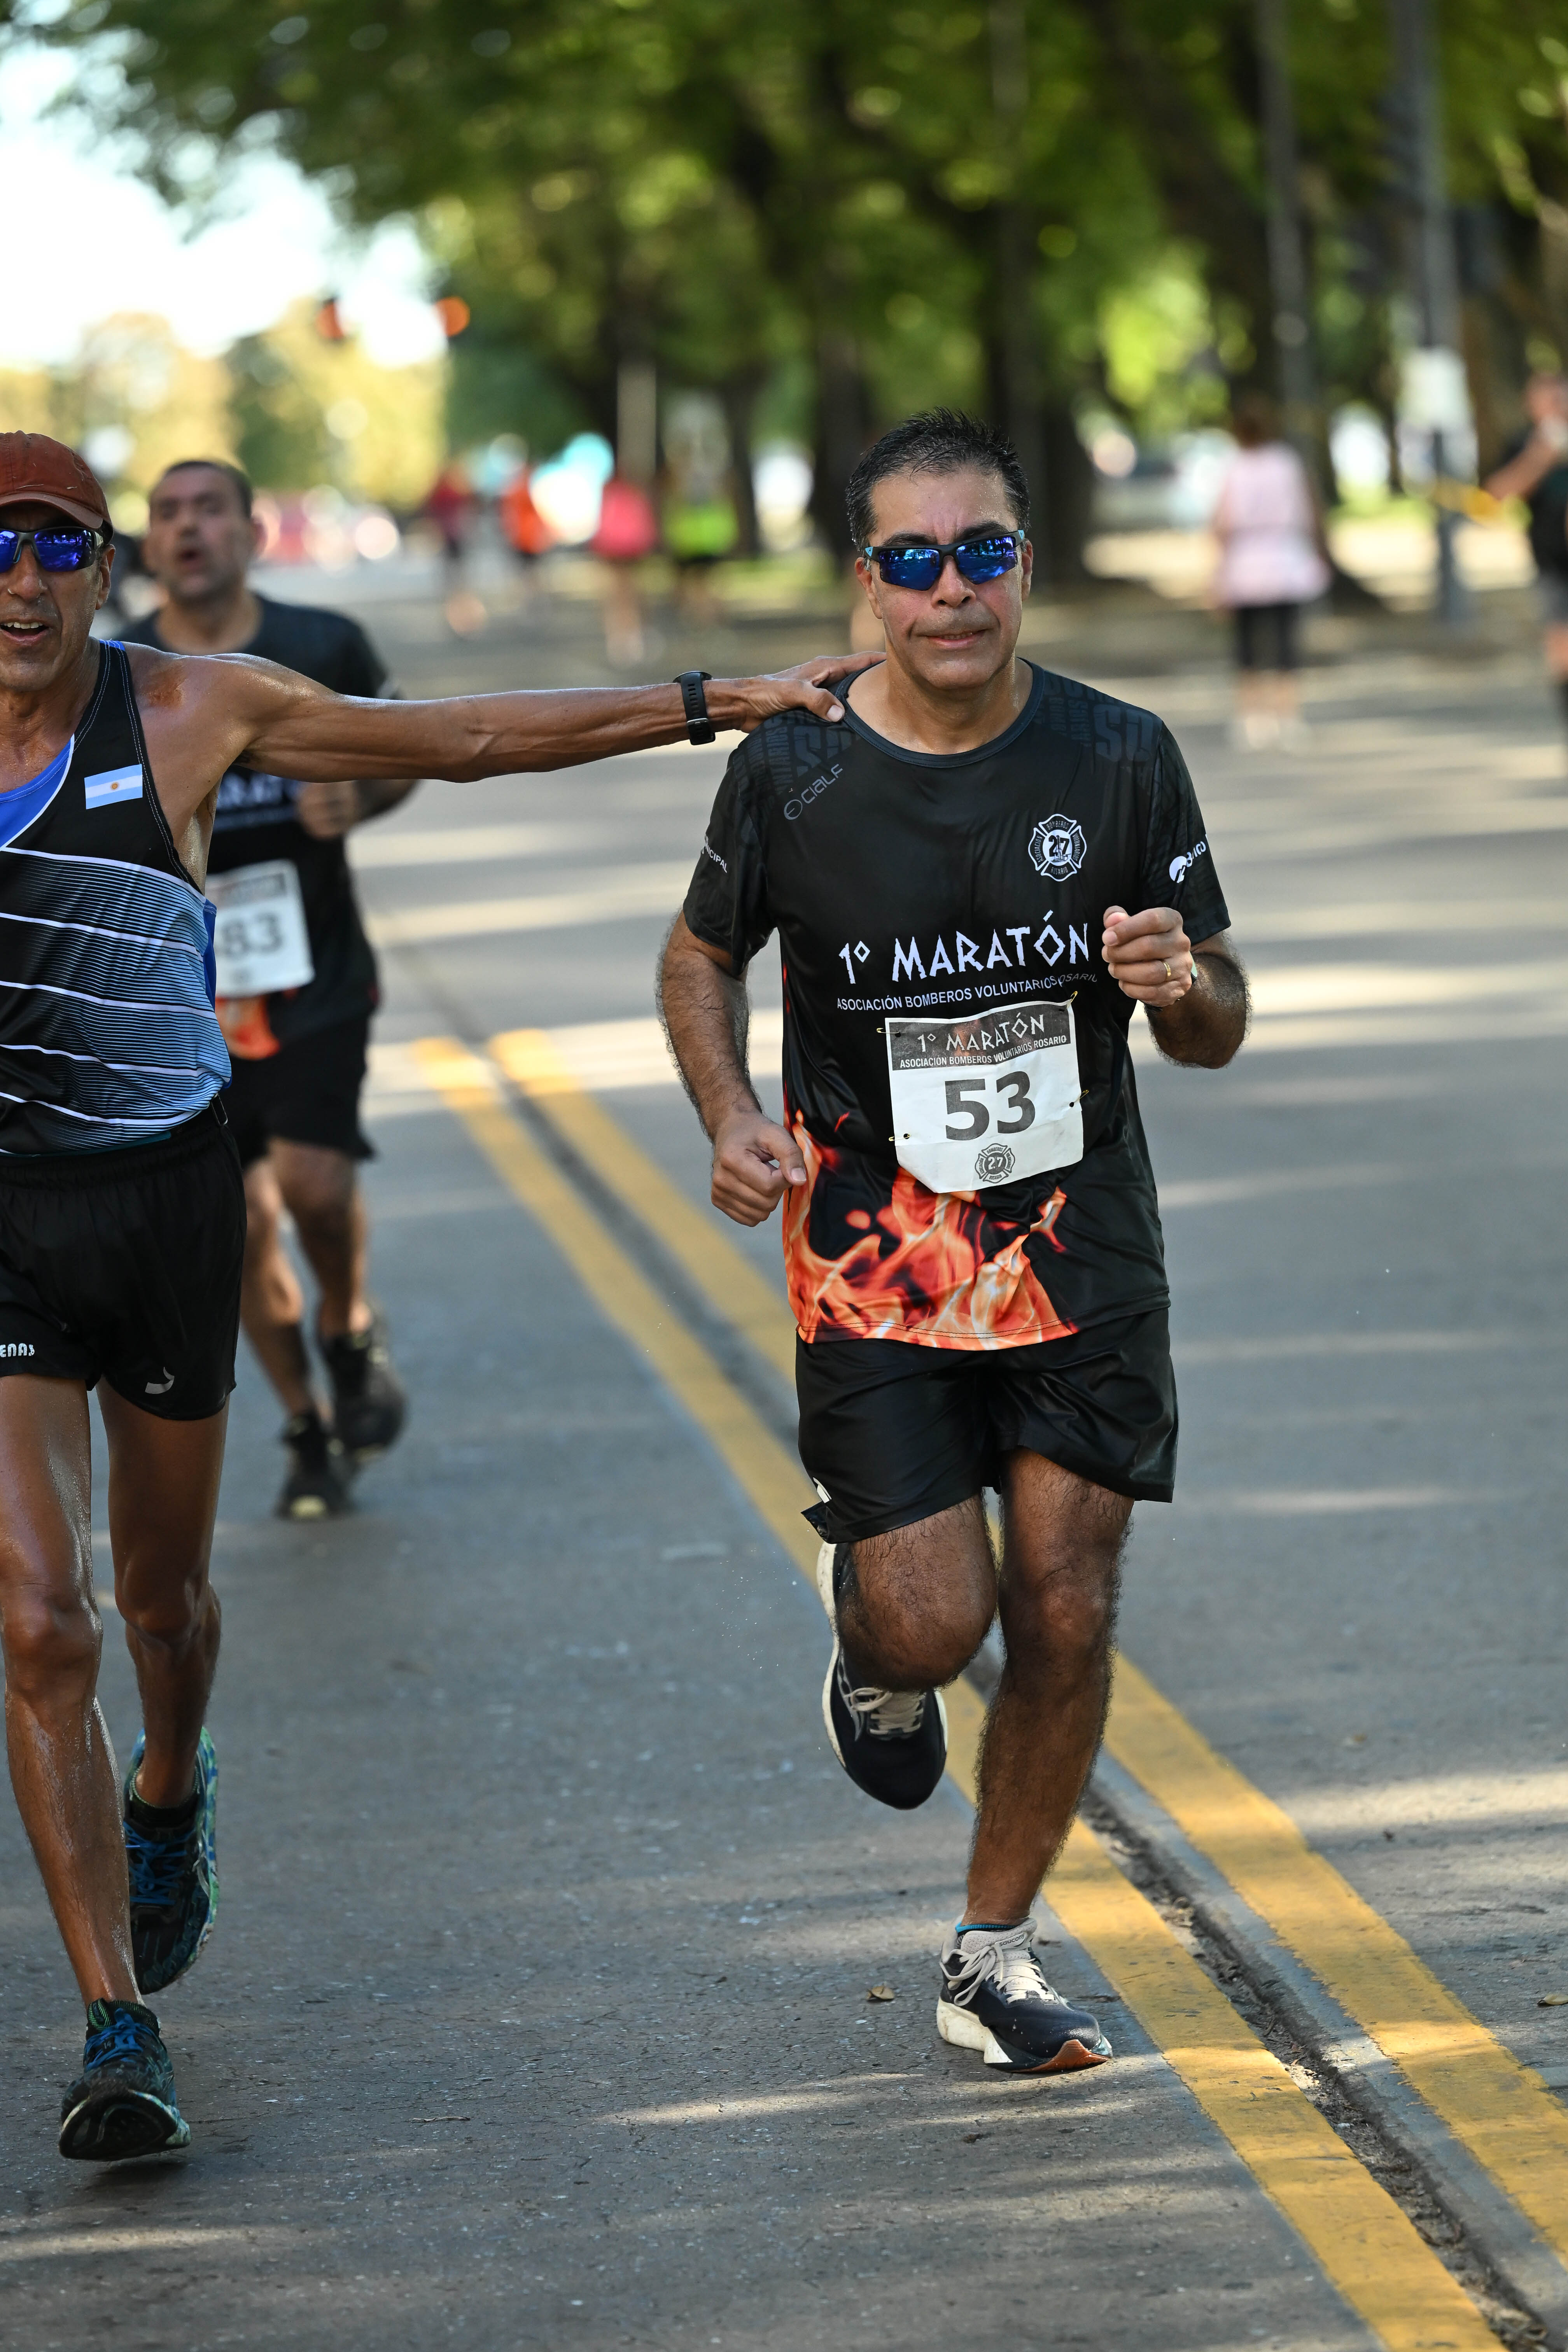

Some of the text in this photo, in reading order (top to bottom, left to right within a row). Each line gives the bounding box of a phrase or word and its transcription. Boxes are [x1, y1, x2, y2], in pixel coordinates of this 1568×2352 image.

[1048, 835, 1070, 857] 27
[892, 909, 1089, 982] MARATÓN
[837, 994, 903, 1011] ASOCIACIÓN
[905, 988, 973, 1008] BOMBEROS
[974, 975, 1058, 999] VOLUNTARIOS
[946, 1012, 1045, 1051] MARATÓN
[900, 1035, 1068, 1068] ASOCIACIÓN BOMBEROS VOLUNTARIOS ROSARIO
[944, 1071, 1036, 1141] 53
[988, 1156, 1003, 1170] 27
